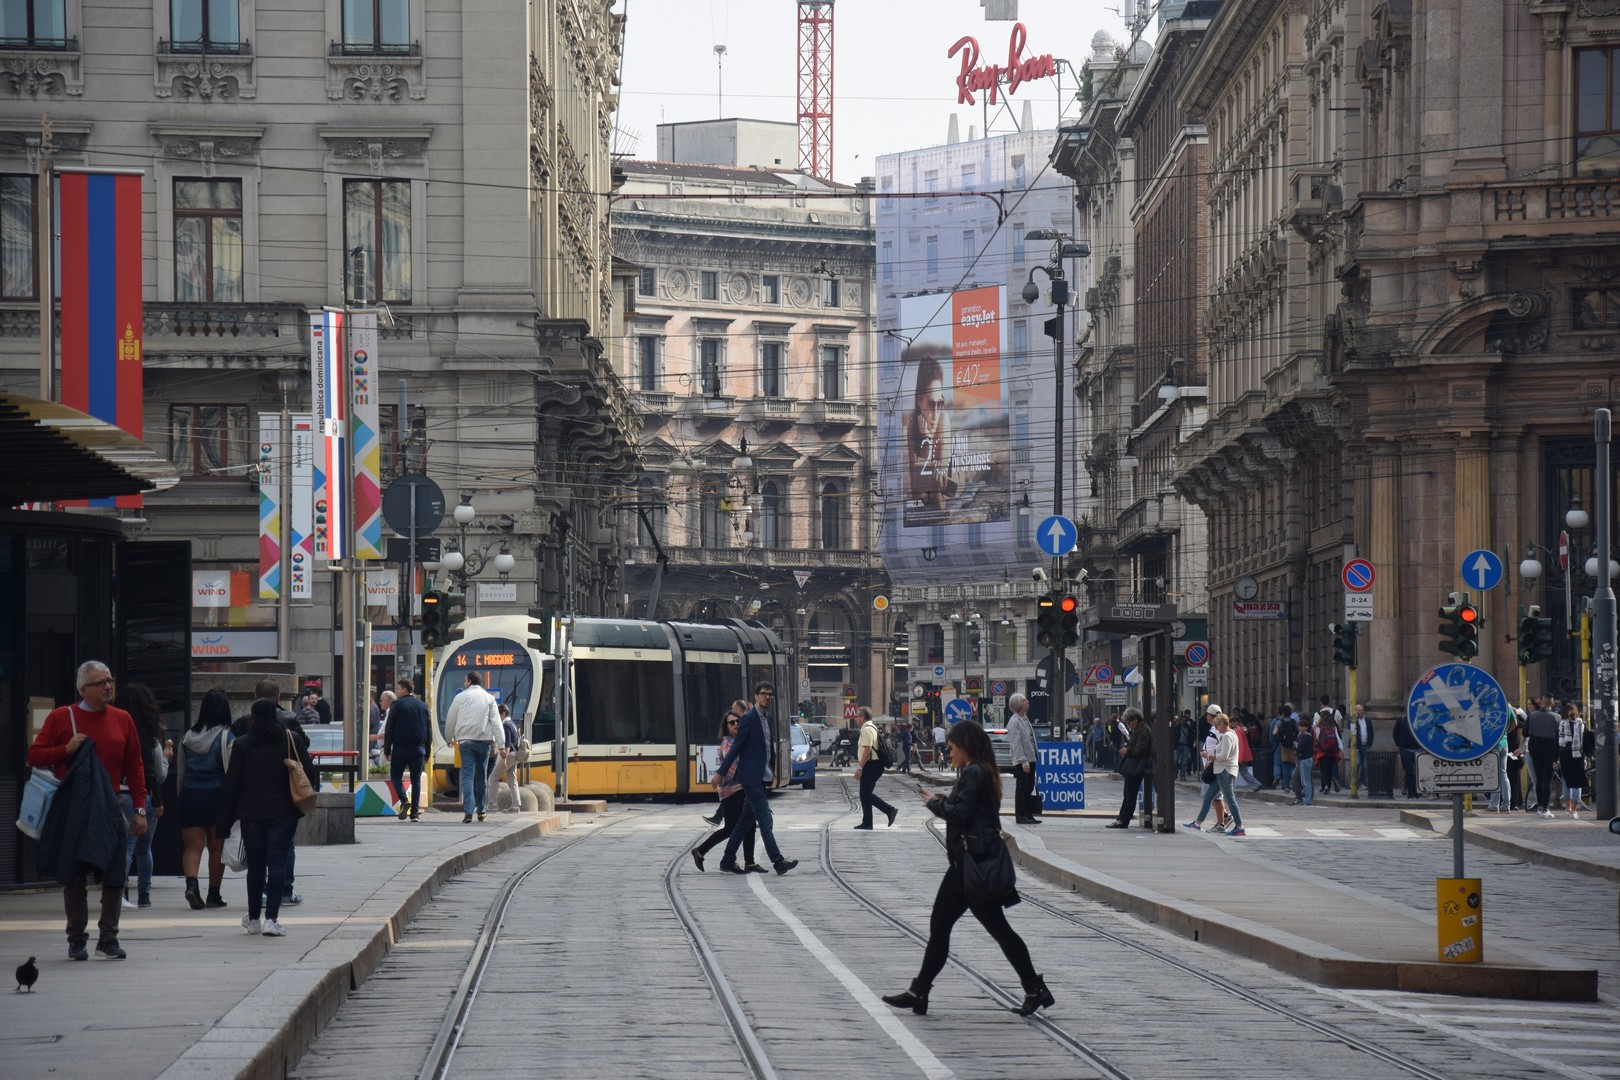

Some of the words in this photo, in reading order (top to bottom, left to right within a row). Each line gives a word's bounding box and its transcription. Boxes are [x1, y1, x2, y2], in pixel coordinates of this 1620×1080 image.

[948, 22, 1056, 106] Ray-Ban
[961, 305, 982, 315] generation
[961, 309, 996, 328] easyJet
[316, 340, 324, 388] dominicana
[353, 349, 368, 405] EXPO
[317, 390, 325, 433] repubblica
[952, 434, 968, 454] ANNI
[951, 454, 960, 473] DI
[960, 452, 991, 472] SPIAGGE
[315, 500, 328, 552] EXPO
[293, 553, 304, 592] EXPO
[197, 588, 226, 596] WIND
[191, 645, 230, 654] WIND
[457, 655, 467, 666] 14
[483, 653, 514, 666] MAGGIORE
[844, 706, 857, 717] M
[1038, 748, 1082, 766] TRAM
[1037, 776, 1042, 784] A
[1045, 772, 1084, 784] PASSO
[1038, 790, 1084, 803] D'UOMO
